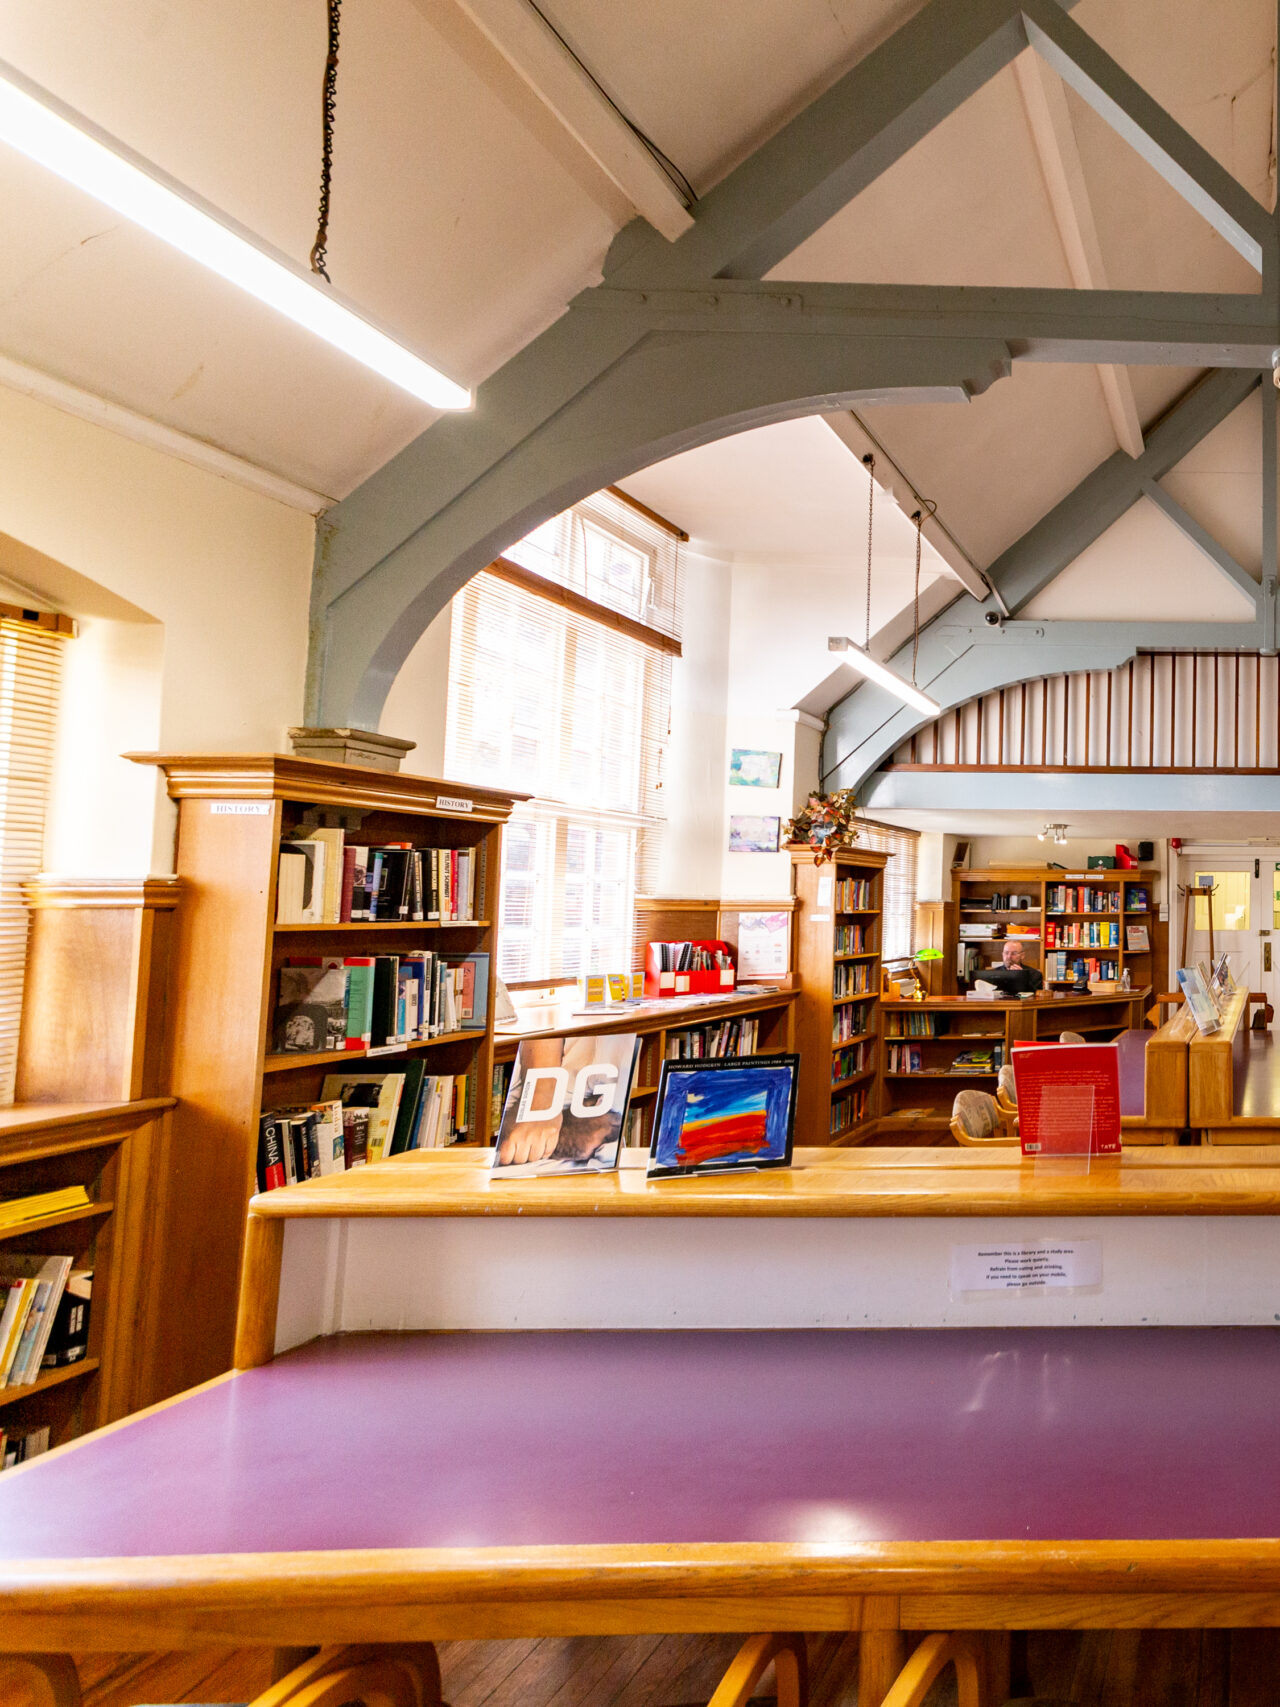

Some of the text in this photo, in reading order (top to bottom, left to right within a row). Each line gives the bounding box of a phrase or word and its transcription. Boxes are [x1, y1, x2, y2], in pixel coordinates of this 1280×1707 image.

[216, 804, 262, 813] HISTORY
[438, 798, 469, 808] HISTORY
[515, 1063, 619, 1123] DG
[265, 1126, 279, 1167] CHINA
